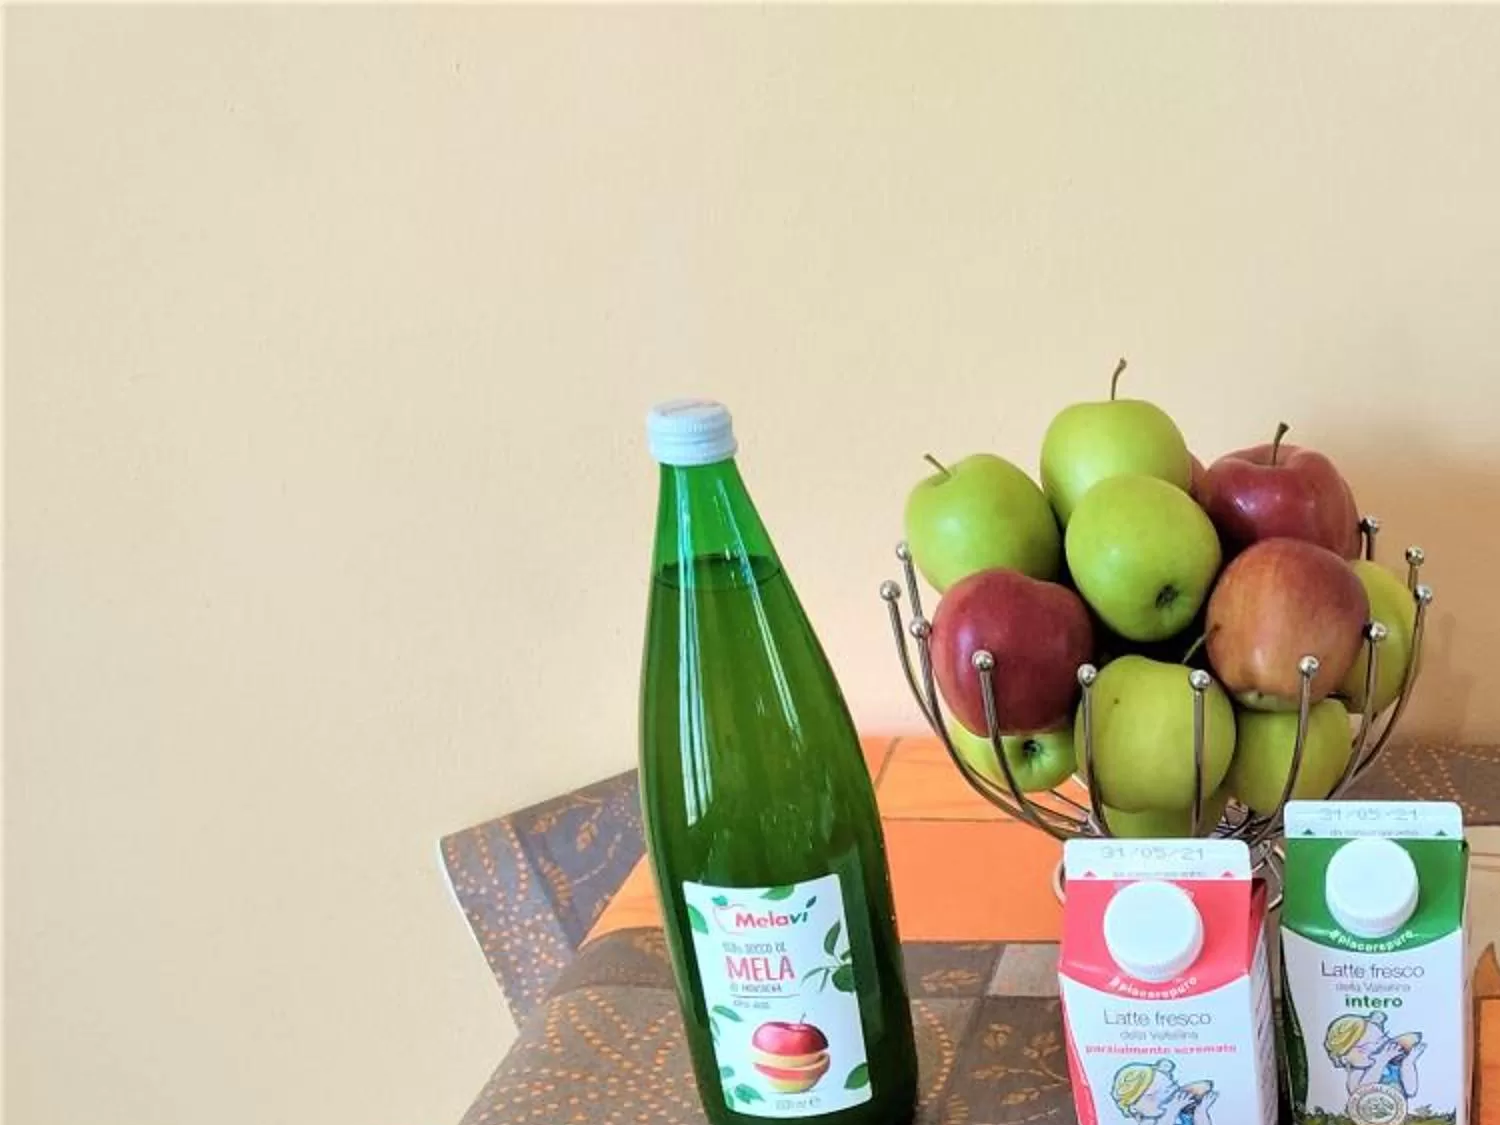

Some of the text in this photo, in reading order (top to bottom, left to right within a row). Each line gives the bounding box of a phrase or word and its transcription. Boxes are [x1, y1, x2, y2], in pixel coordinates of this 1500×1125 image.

[725, 954, 795, 983] MELA
[1320, 959, 1426, 980] Latte fresco
[1344, 993, 1404, 1009] intero
[1103, 1008, 1213, 1027] Latte fresco
